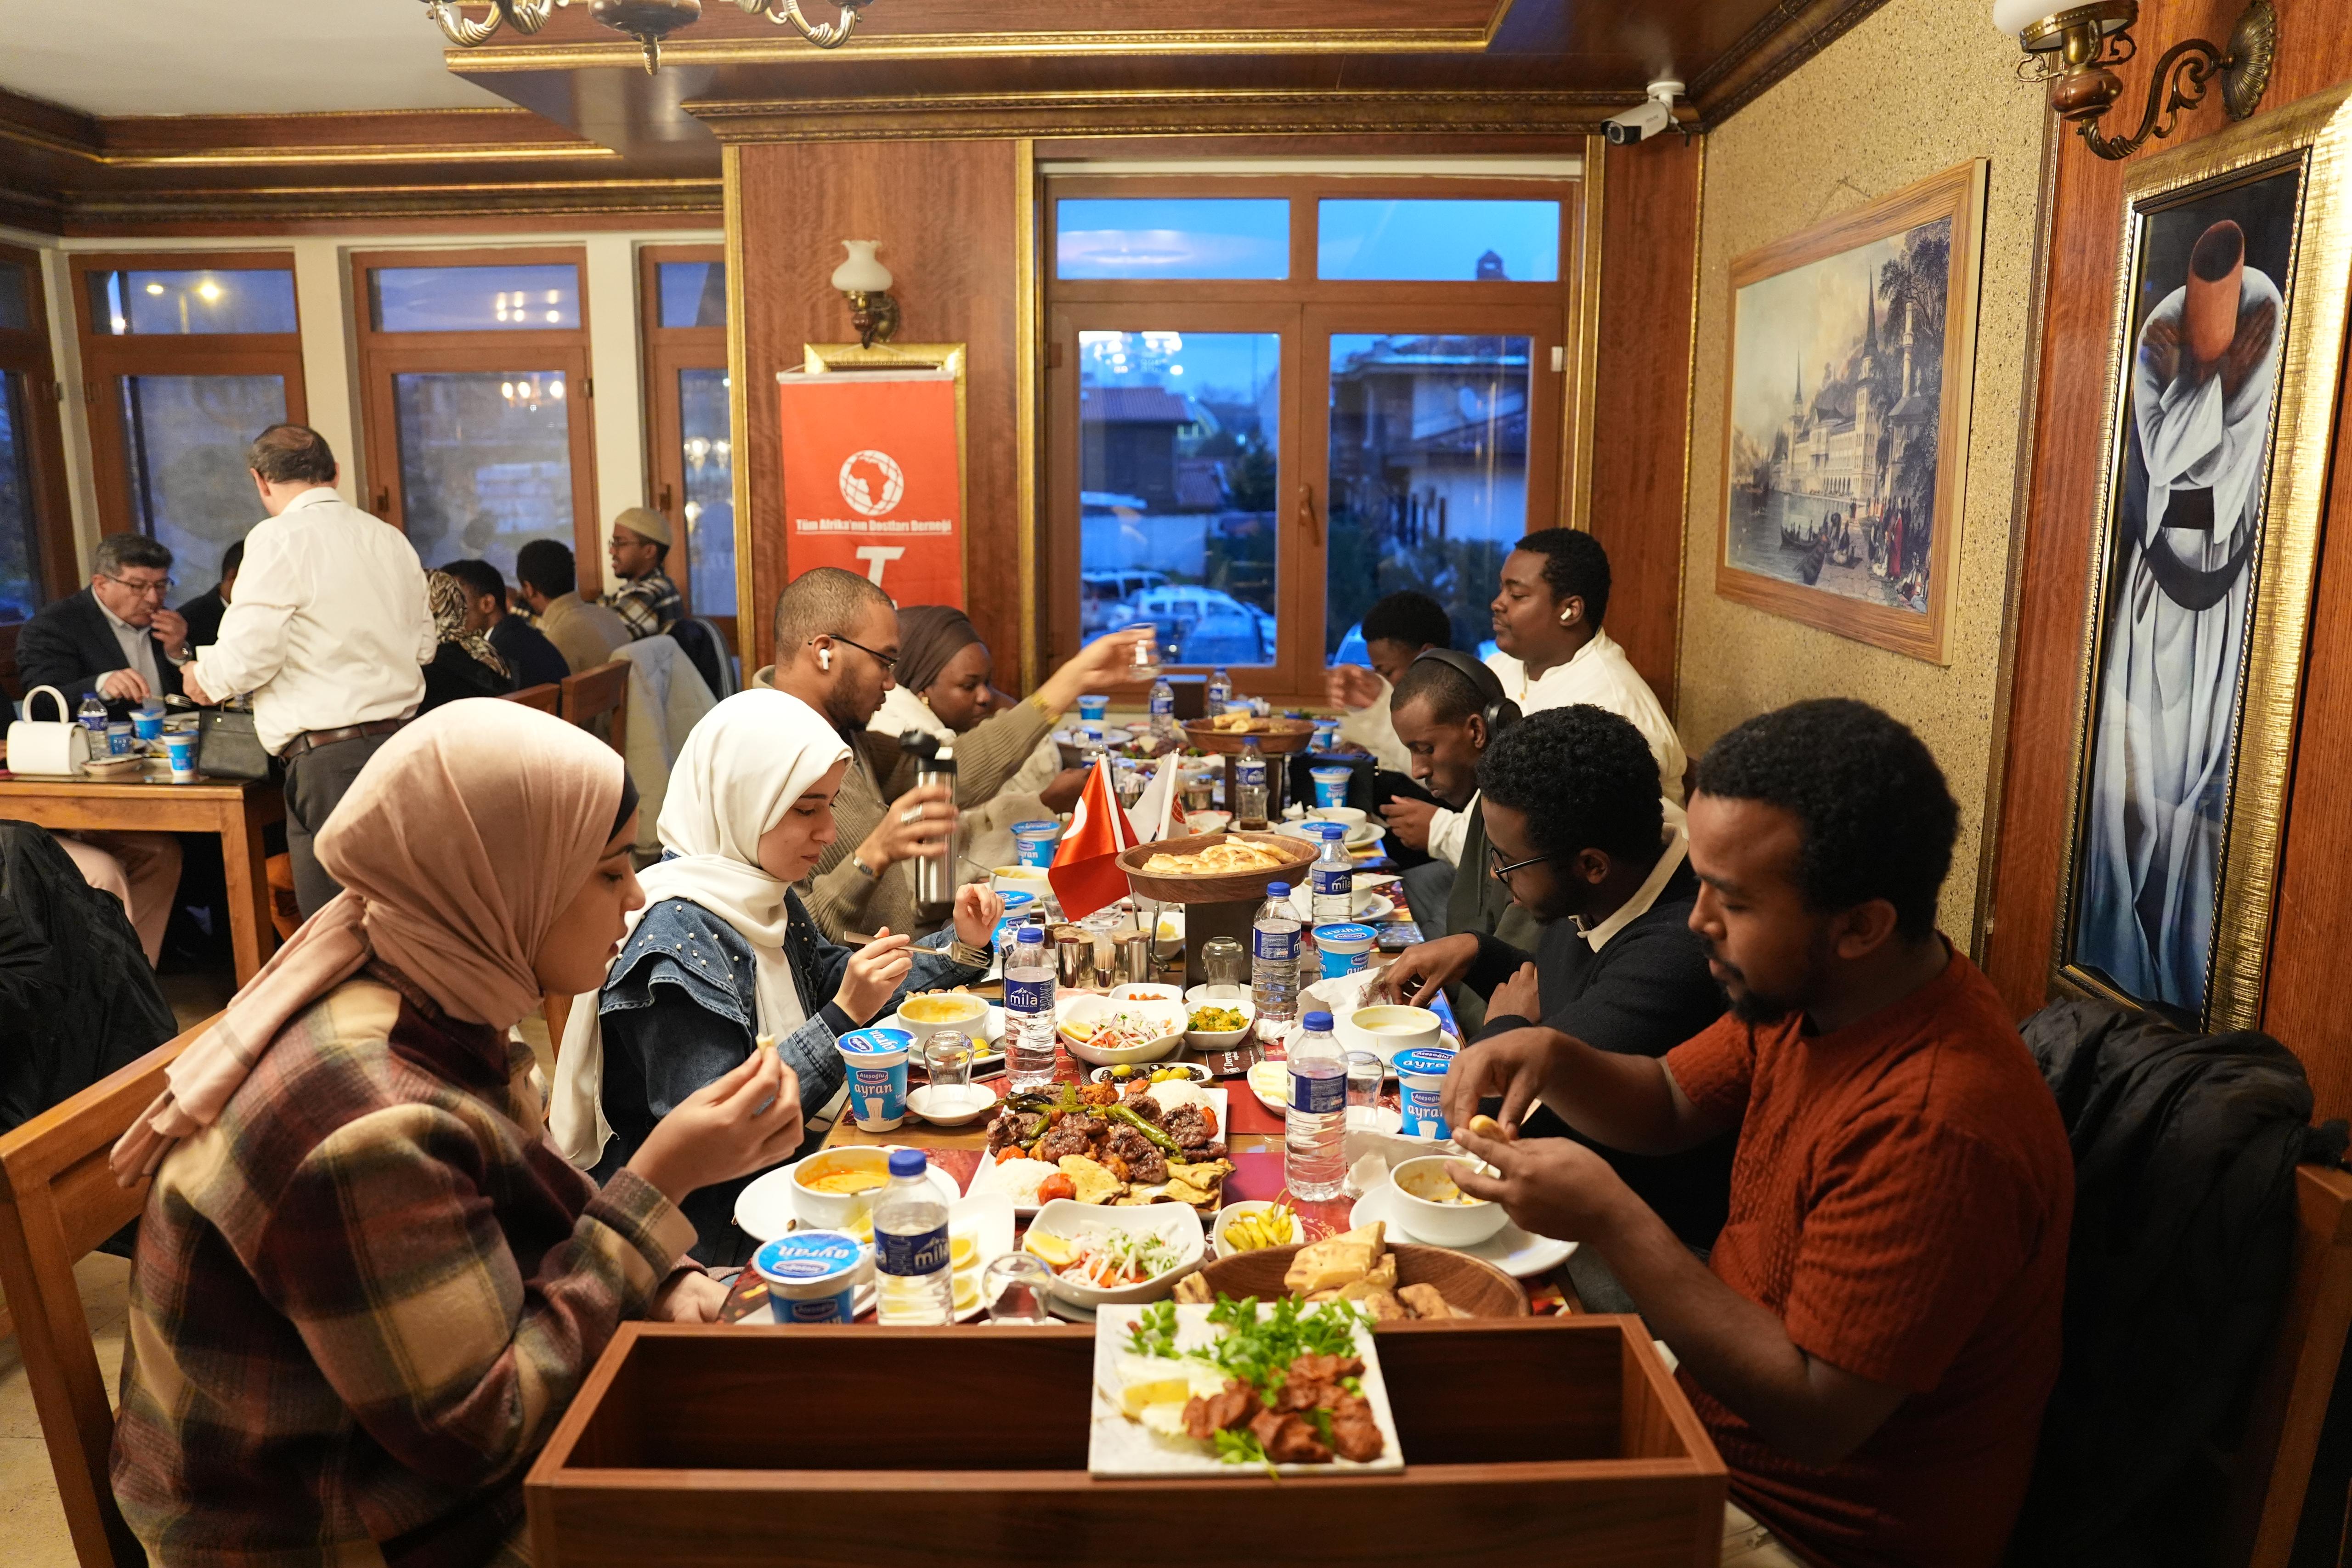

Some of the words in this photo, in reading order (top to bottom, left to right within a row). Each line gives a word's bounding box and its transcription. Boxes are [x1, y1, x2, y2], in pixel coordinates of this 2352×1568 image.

[796, 519, 819, 531] Tüm
[911, 519, 952, 532] Derneği
[1332, 879, 1351, 891] mila
[1010, 994, 1038, 1005] mila
[1040, 980, 1052, 1011] SAPANCA
[854, 1084, 893, 1098] ayran
[779, 1245, 849, 1259] ayran
